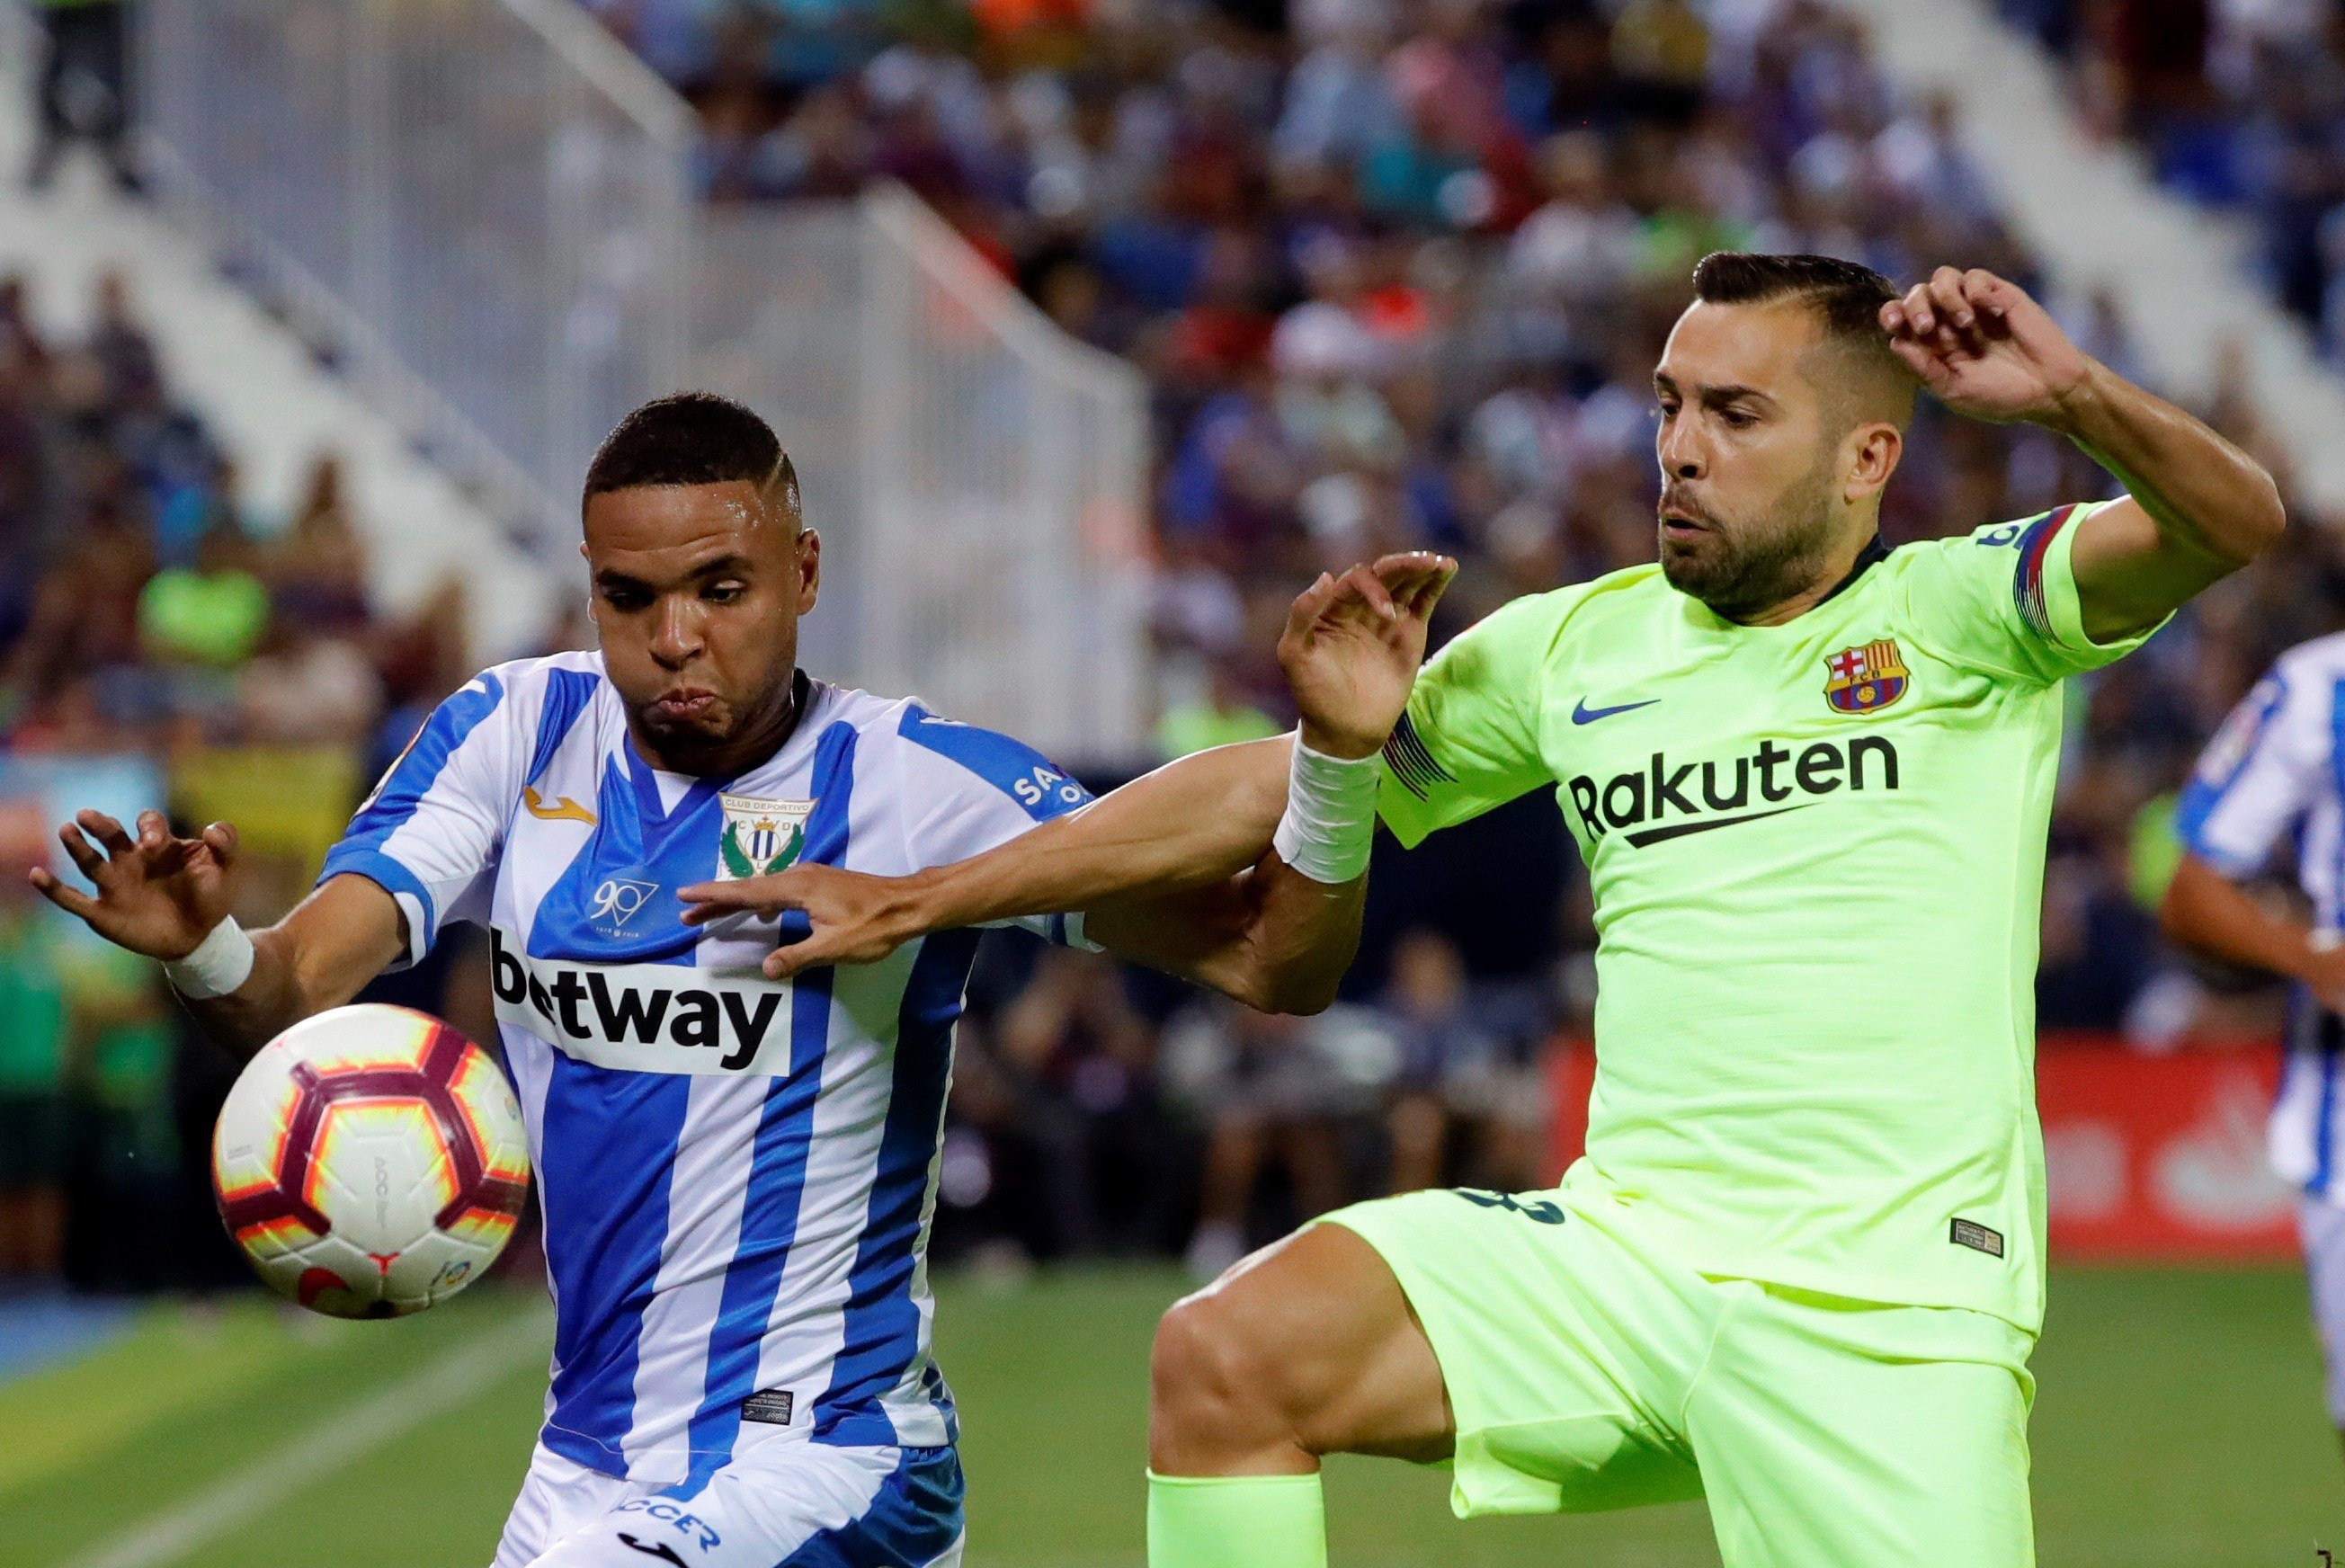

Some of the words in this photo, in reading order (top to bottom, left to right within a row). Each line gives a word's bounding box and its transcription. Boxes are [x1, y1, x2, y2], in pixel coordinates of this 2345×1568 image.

[725, 798, 751, 807] CLUB
[753, 801, 809, 811] DEPORTIVO
[1569, 735, 1899, 843] Rakuten
[590, 880, 642, 919] 90
[490, 926, 782, 1070] betway
